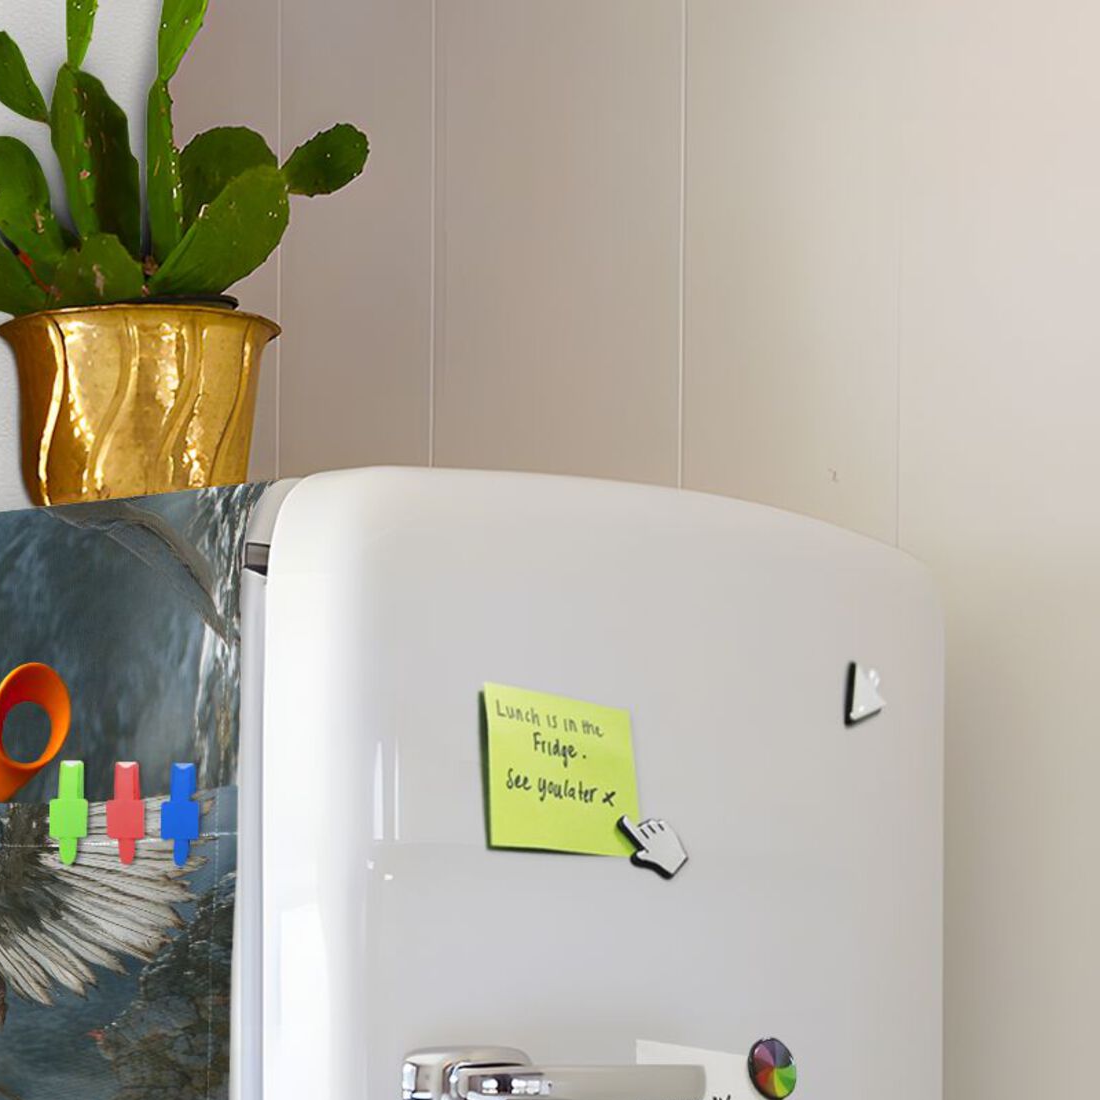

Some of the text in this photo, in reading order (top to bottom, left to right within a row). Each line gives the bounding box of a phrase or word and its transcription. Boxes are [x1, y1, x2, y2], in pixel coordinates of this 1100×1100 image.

[496, 699, 604, 737] Lunch is in the
[506, 768, 532, 790] See
